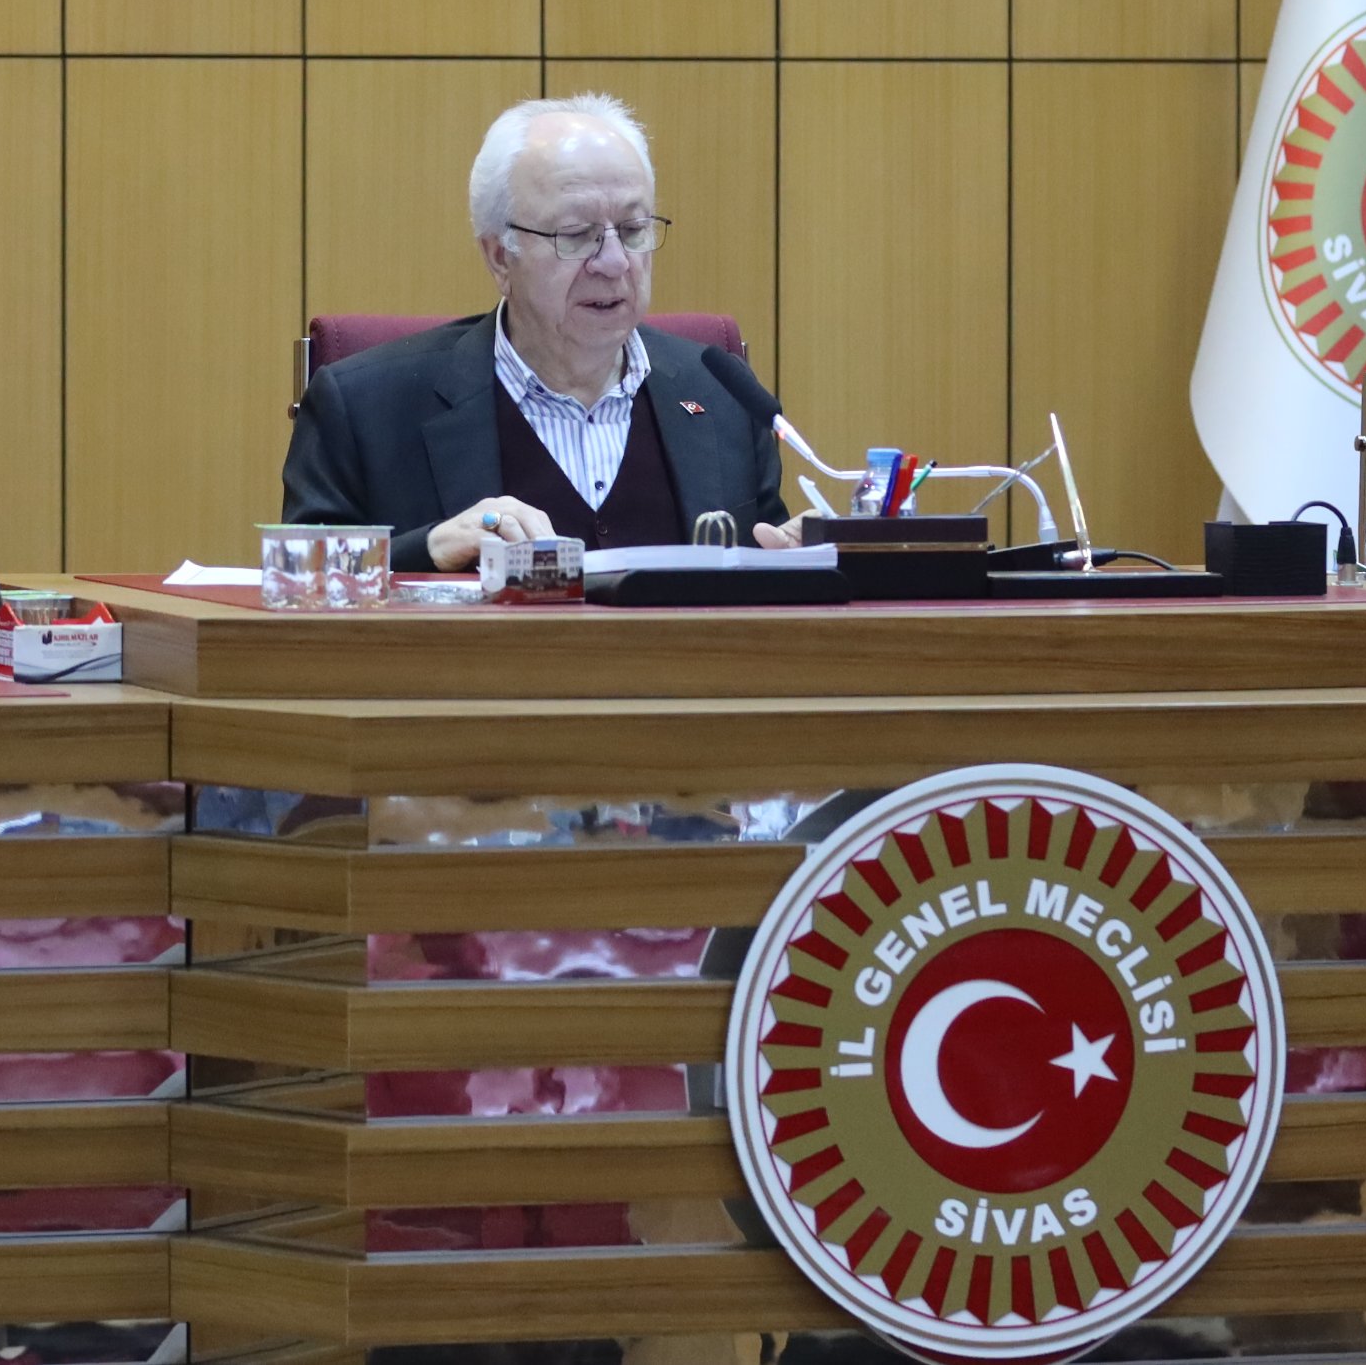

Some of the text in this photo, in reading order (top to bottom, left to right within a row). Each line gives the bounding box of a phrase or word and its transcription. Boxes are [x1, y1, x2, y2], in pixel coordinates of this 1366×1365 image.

[829, 877, 1187, 1078] İL GENEL MECLİSİ
[935, 1187, 1098, 1246] SİVAS
